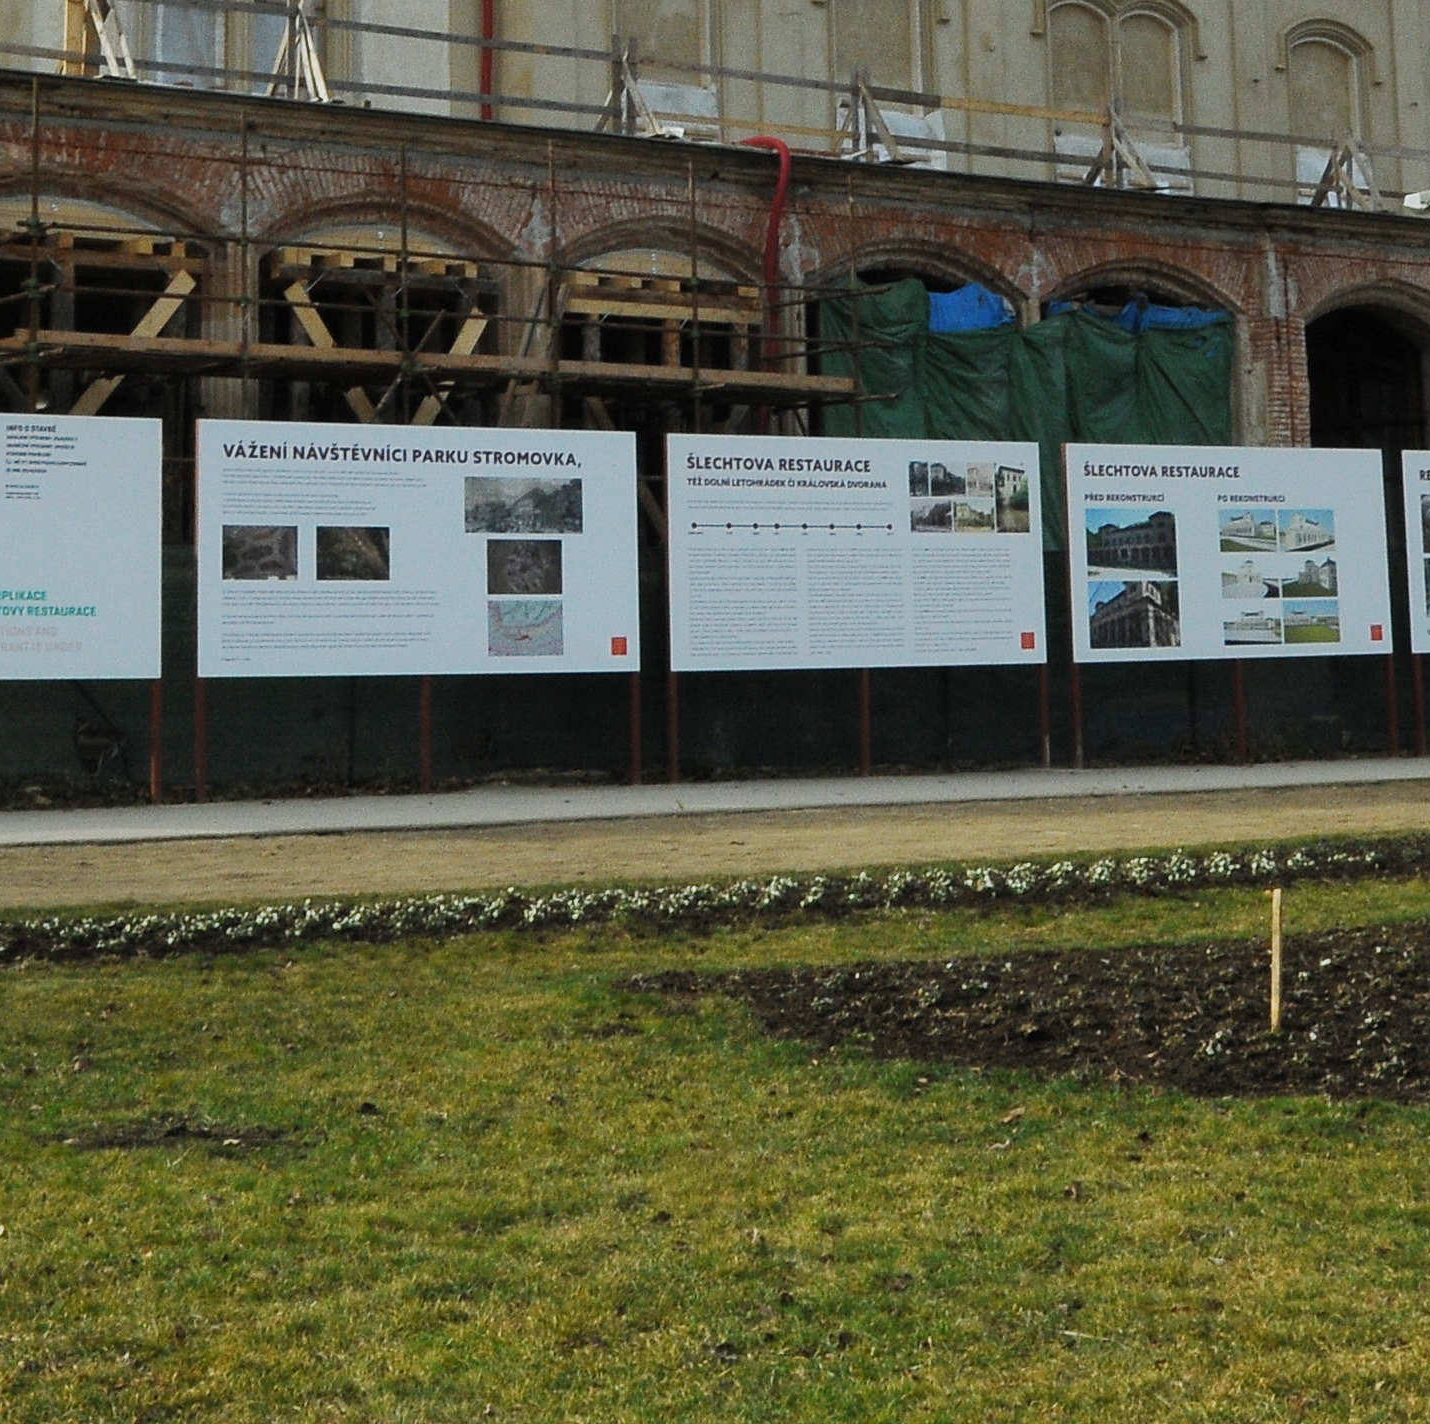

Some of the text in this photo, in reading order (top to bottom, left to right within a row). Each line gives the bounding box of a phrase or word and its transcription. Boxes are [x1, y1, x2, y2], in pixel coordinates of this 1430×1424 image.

[222, 440, 287, 459] VÁŽENÍ
[411, 449, 468, 464] PARKU
[473, 451, 583, 469] STROMOVKA,
[686, 452, 871, 473] ŠLECHTOVA RESTAURACE
[1083, 461, 1241, 479] ŠLECHTOVA RESTAURACE
[1217, 494, 1228, 503] PO
[27, 606, 97, 617] RESTAURACE
